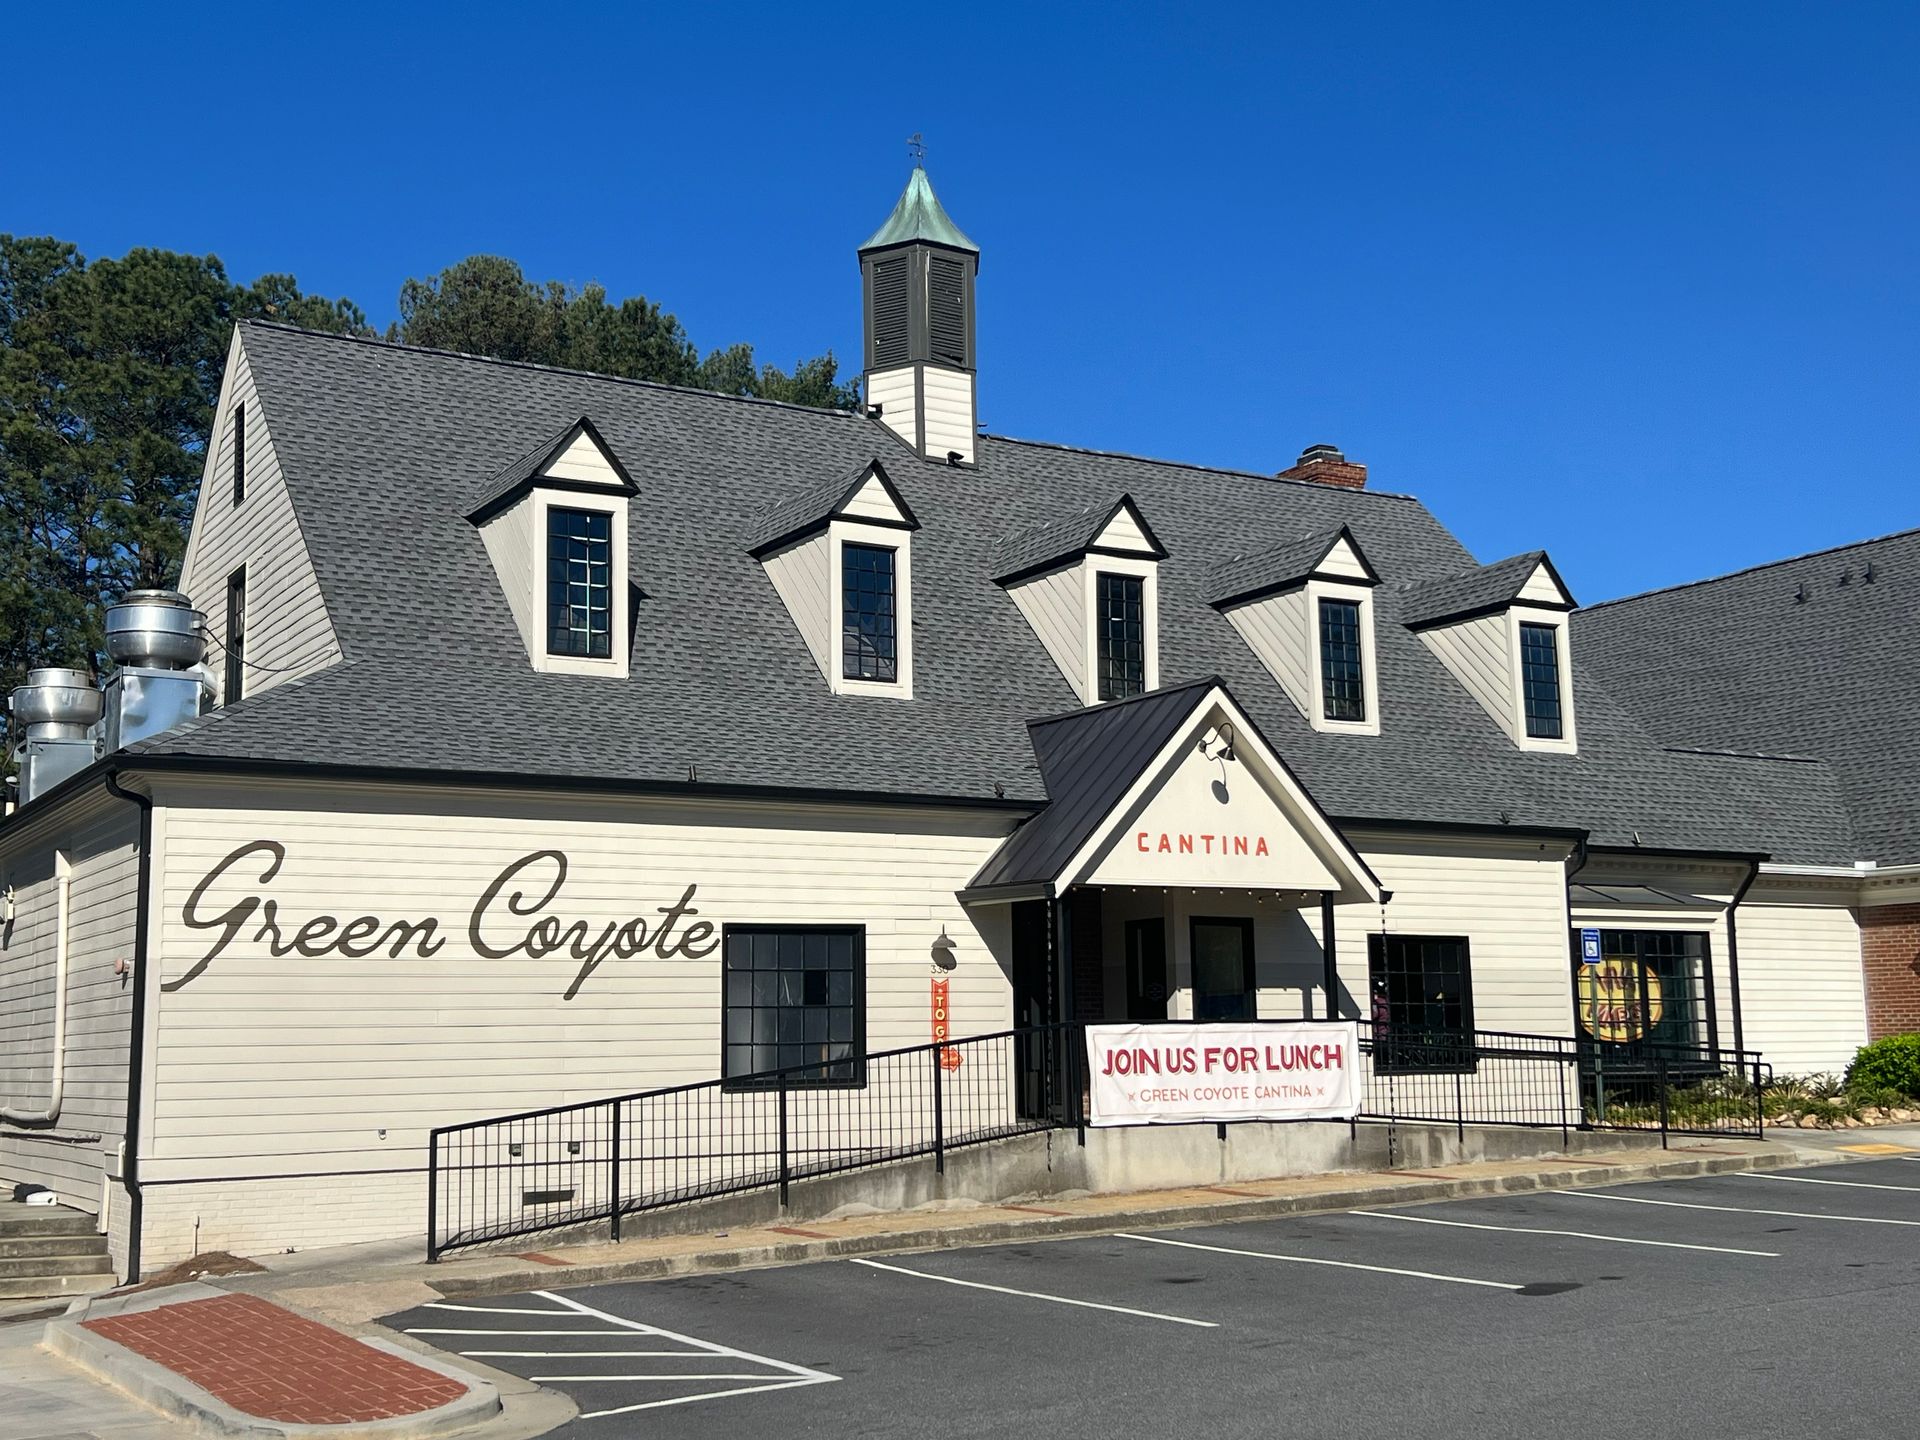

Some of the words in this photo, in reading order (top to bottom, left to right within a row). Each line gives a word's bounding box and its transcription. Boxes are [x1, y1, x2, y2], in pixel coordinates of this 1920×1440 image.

[1137, 832, 1269, 856] CANTINA
[160, 840, 446, 992] Green
[468, 850, 720, 1001] Coyote
[1102, 1048, 1163, 1076] JOIN
[1165, 1047, 1197, 1074] US
[1204, 1046, 1259, 1074] FOR
[1265, 1044, 1344, 1072] LUNCH
[1140, 1087, 1189, 1103] GREEN
[1193, 1086, 1249, 1101] COYOTE
[1254, 1085, 1312, 1099] CANTINA
